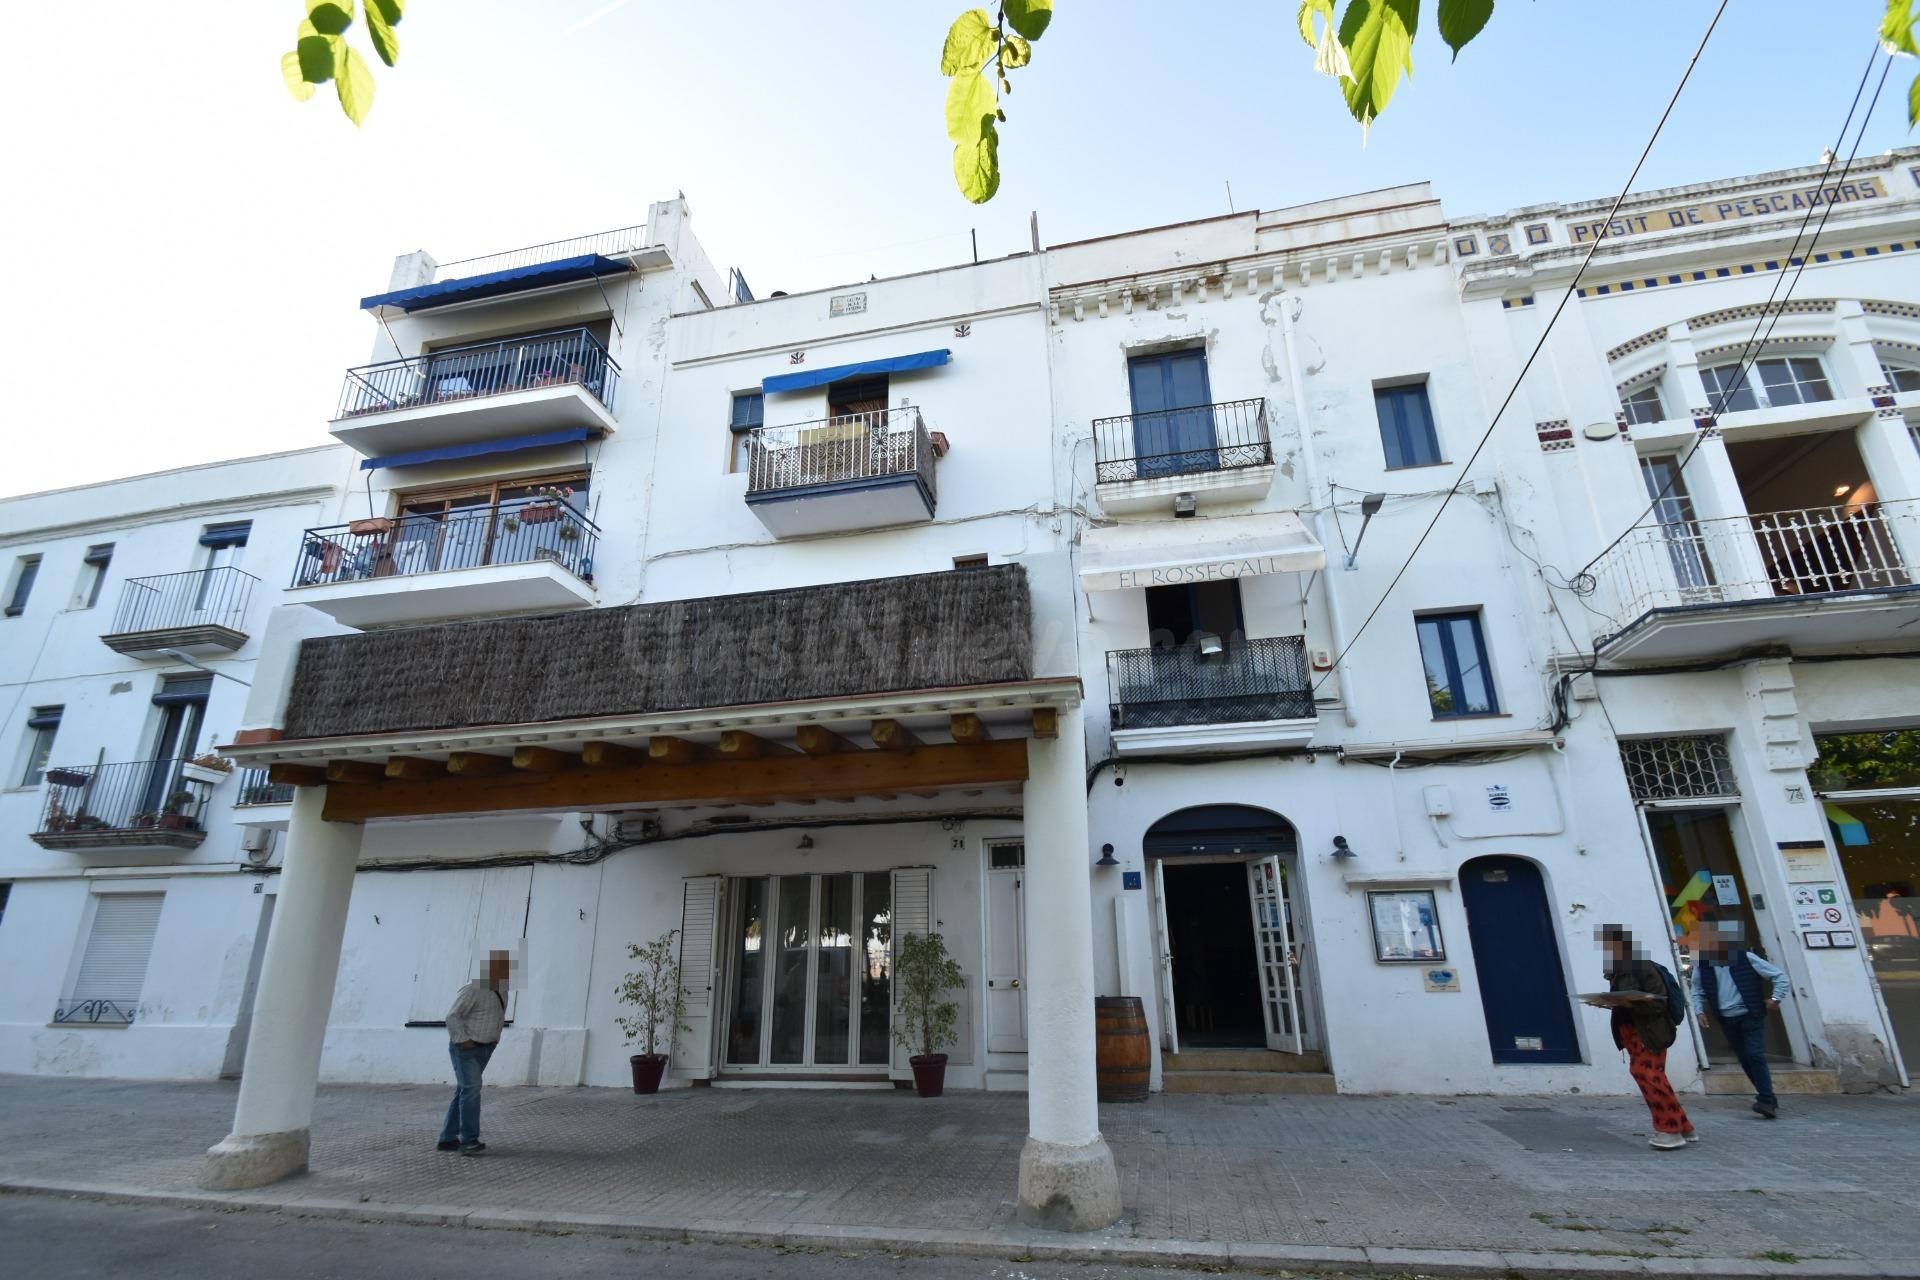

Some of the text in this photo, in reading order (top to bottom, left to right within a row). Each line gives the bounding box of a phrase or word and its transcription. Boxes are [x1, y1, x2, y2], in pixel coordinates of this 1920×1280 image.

[1574, 182, 1877, 242] POSIT DE PESCADORS
[1120, 557, 1283, 587] EL ROSSEGALL
[953, 839, 963, 848] 71
